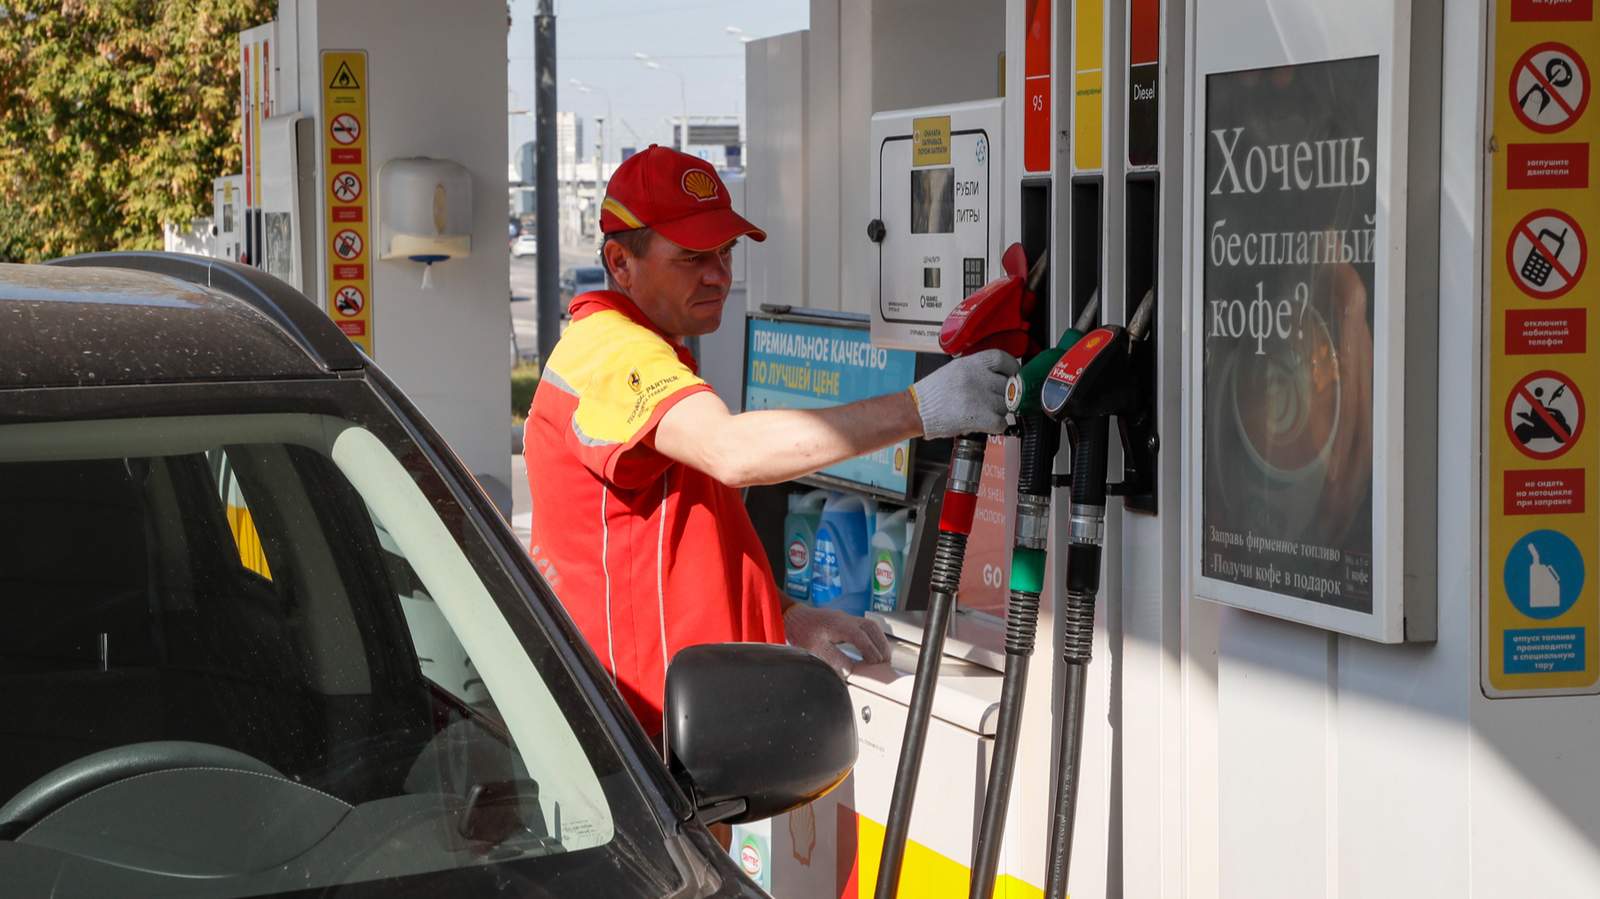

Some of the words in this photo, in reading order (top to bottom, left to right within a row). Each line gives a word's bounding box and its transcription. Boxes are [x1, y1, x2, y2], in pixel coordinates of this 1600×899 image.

[1032, 95, 1043, 112] 95
[1133, 80, 1156, 101] Diesel
[1210, 127, 1370, 195] Хочешь
[956, 181, 979, 196] РУБЛИ
[956, 208, 980, 223] ЛИТРЫ
[1210, 214, 1376, 267] бесплатный
[1210, 281, 1309, 355] кофе?
[754, 329, 829, 362] ПРЕМИАЛЬНОЕ
[830, 339, 888, 370] КАЧЕСТВО
[752, 360, 767, 384] ПО
[768, 361, 811, 391] ЛУЧШЕЙ
[813, 368, 841, 396] ЦЕНЕ
[1210, 525, 1244, 548] Заправь
[1246, 531, 1299, 556] фирменное
[1301, 543, 1341, 562] топливо
[1255, 563, 1281, 588] кофе
[1285, 573, 1291, 585] в
[1294, 573, 1341, 598] подарок
